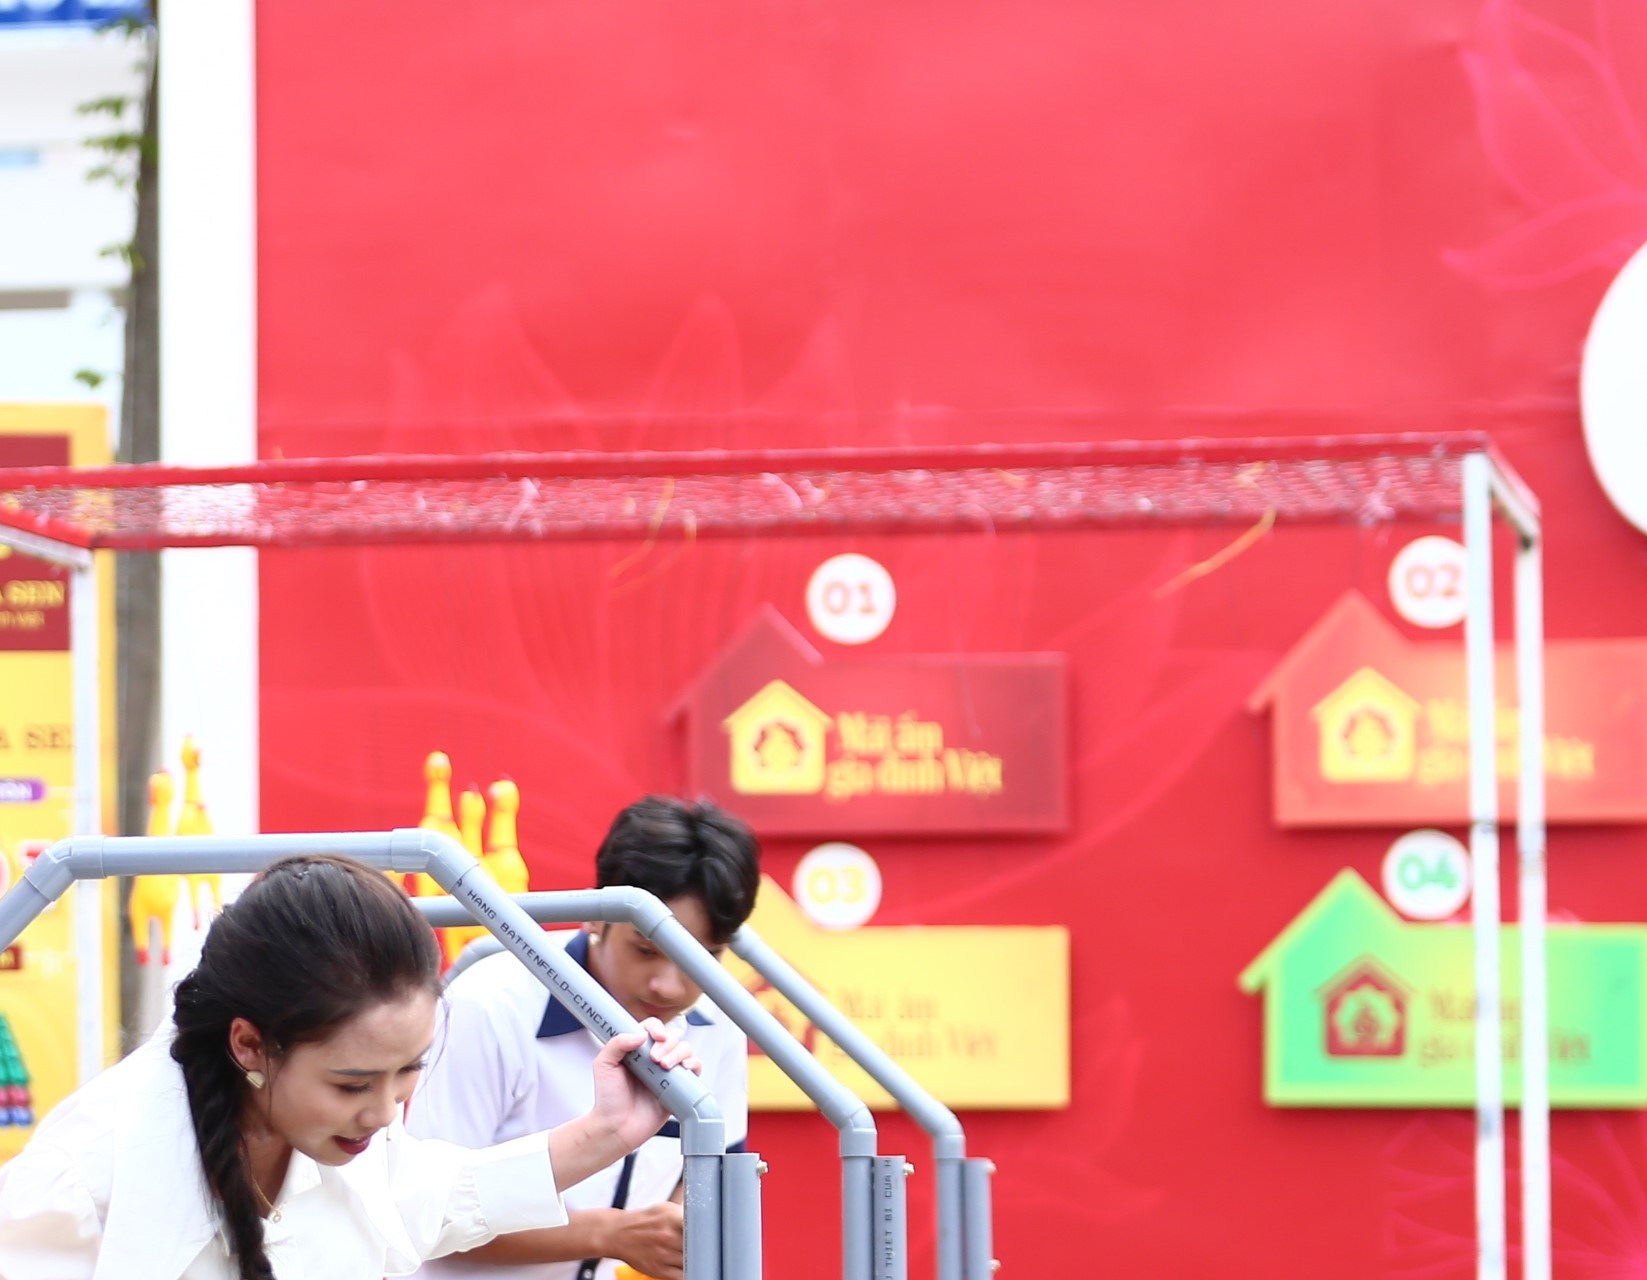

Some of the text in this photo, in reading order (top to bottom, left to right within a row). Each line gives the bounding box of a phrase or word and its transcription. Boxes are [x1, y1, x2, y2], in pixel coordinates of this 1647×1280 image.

[1405, 563, 1461, 598] 02
[822, 582, 876, 616] 01
[24, 723, 74, 749] SE
[807, 865, 867, 905] 03
[1397, 854, 1458, 890] 04
[468, 890, 497, 920] HANG
[499, 920, 642, 1064] BATTENFELD-CINCINI
[885, 1208, 893, 1222] BI
[885, 1231, 893, 1267] THIET
